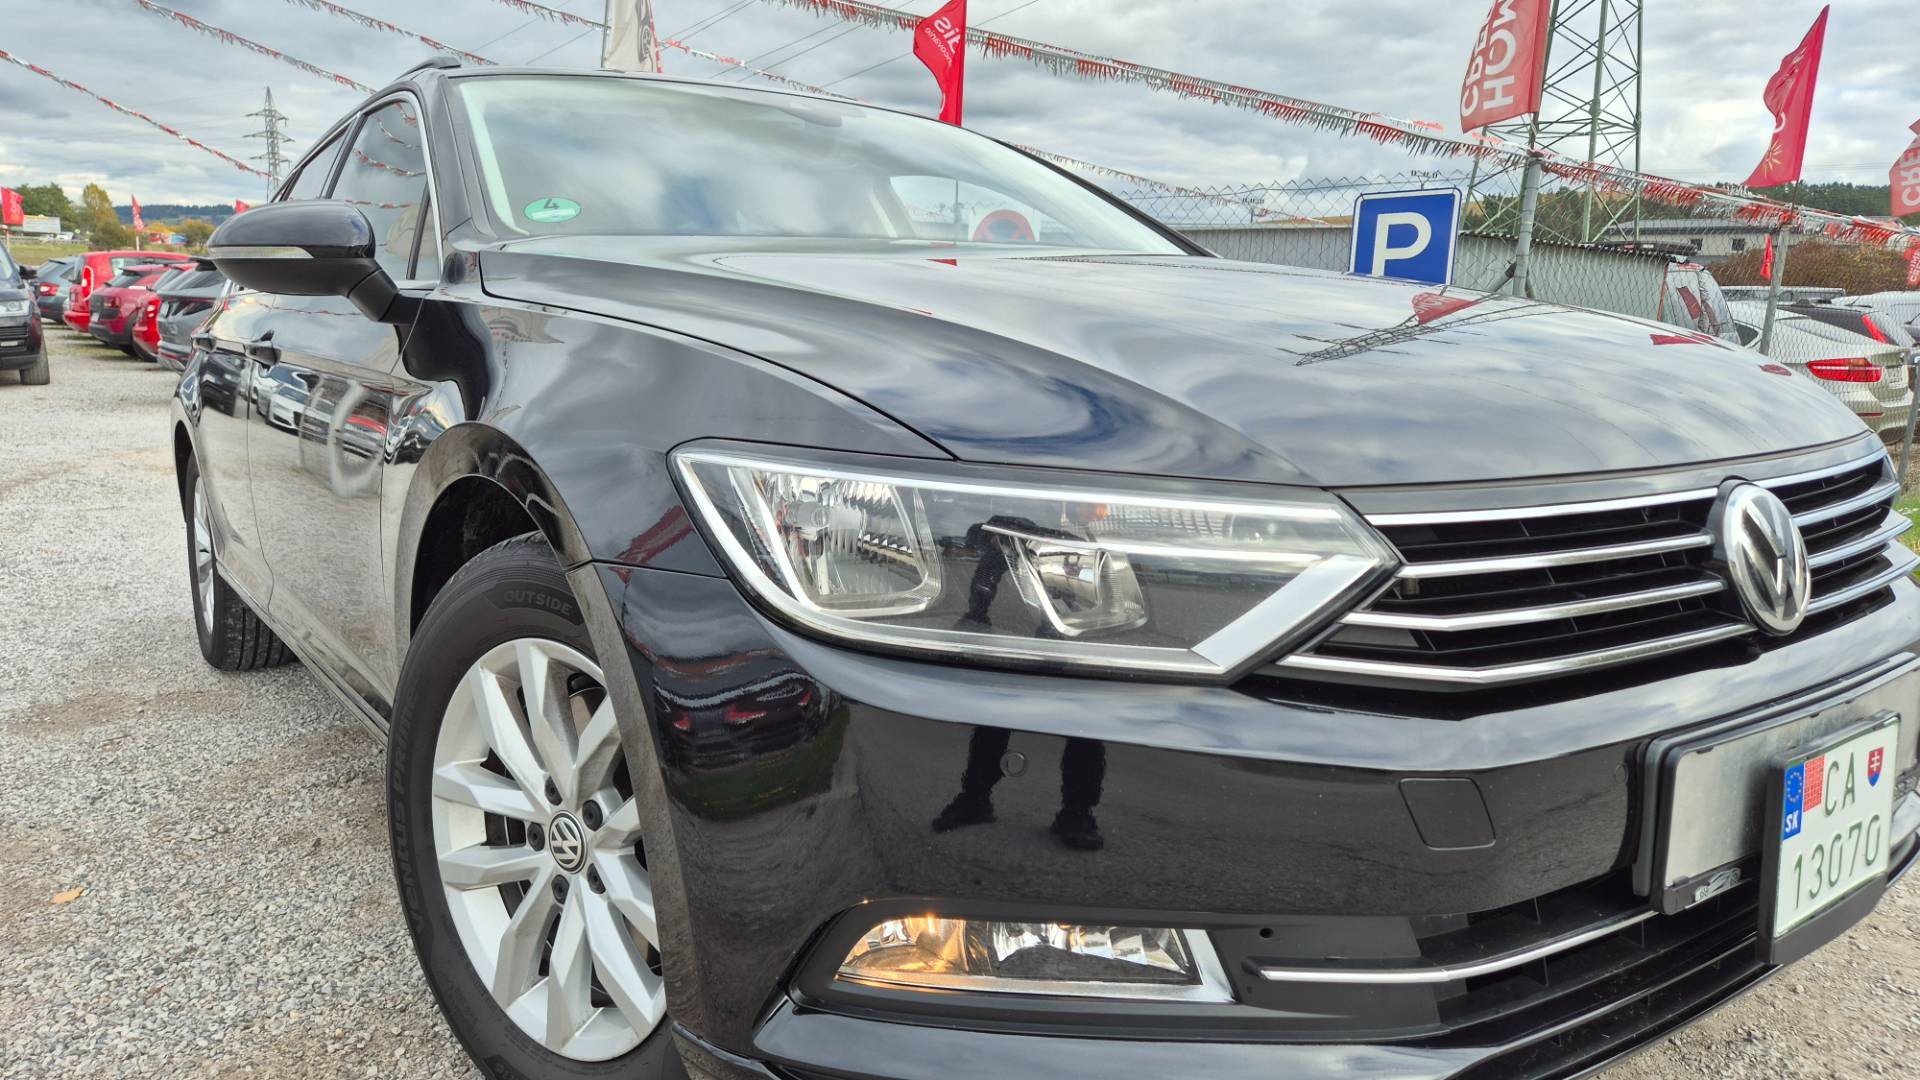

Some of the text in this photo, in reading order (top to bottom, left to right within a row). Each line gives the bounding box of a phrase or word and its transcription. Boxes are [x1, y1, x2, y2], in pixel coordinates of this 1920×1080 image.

[1371, 212, 1432, 276] P
[503, 590, 573, 617] OUTSIDE
[1824, 752, 1856, 816] CA
[1785, 810, 1799, 833] SK
[1794, 814, 1881, 909] 13070
